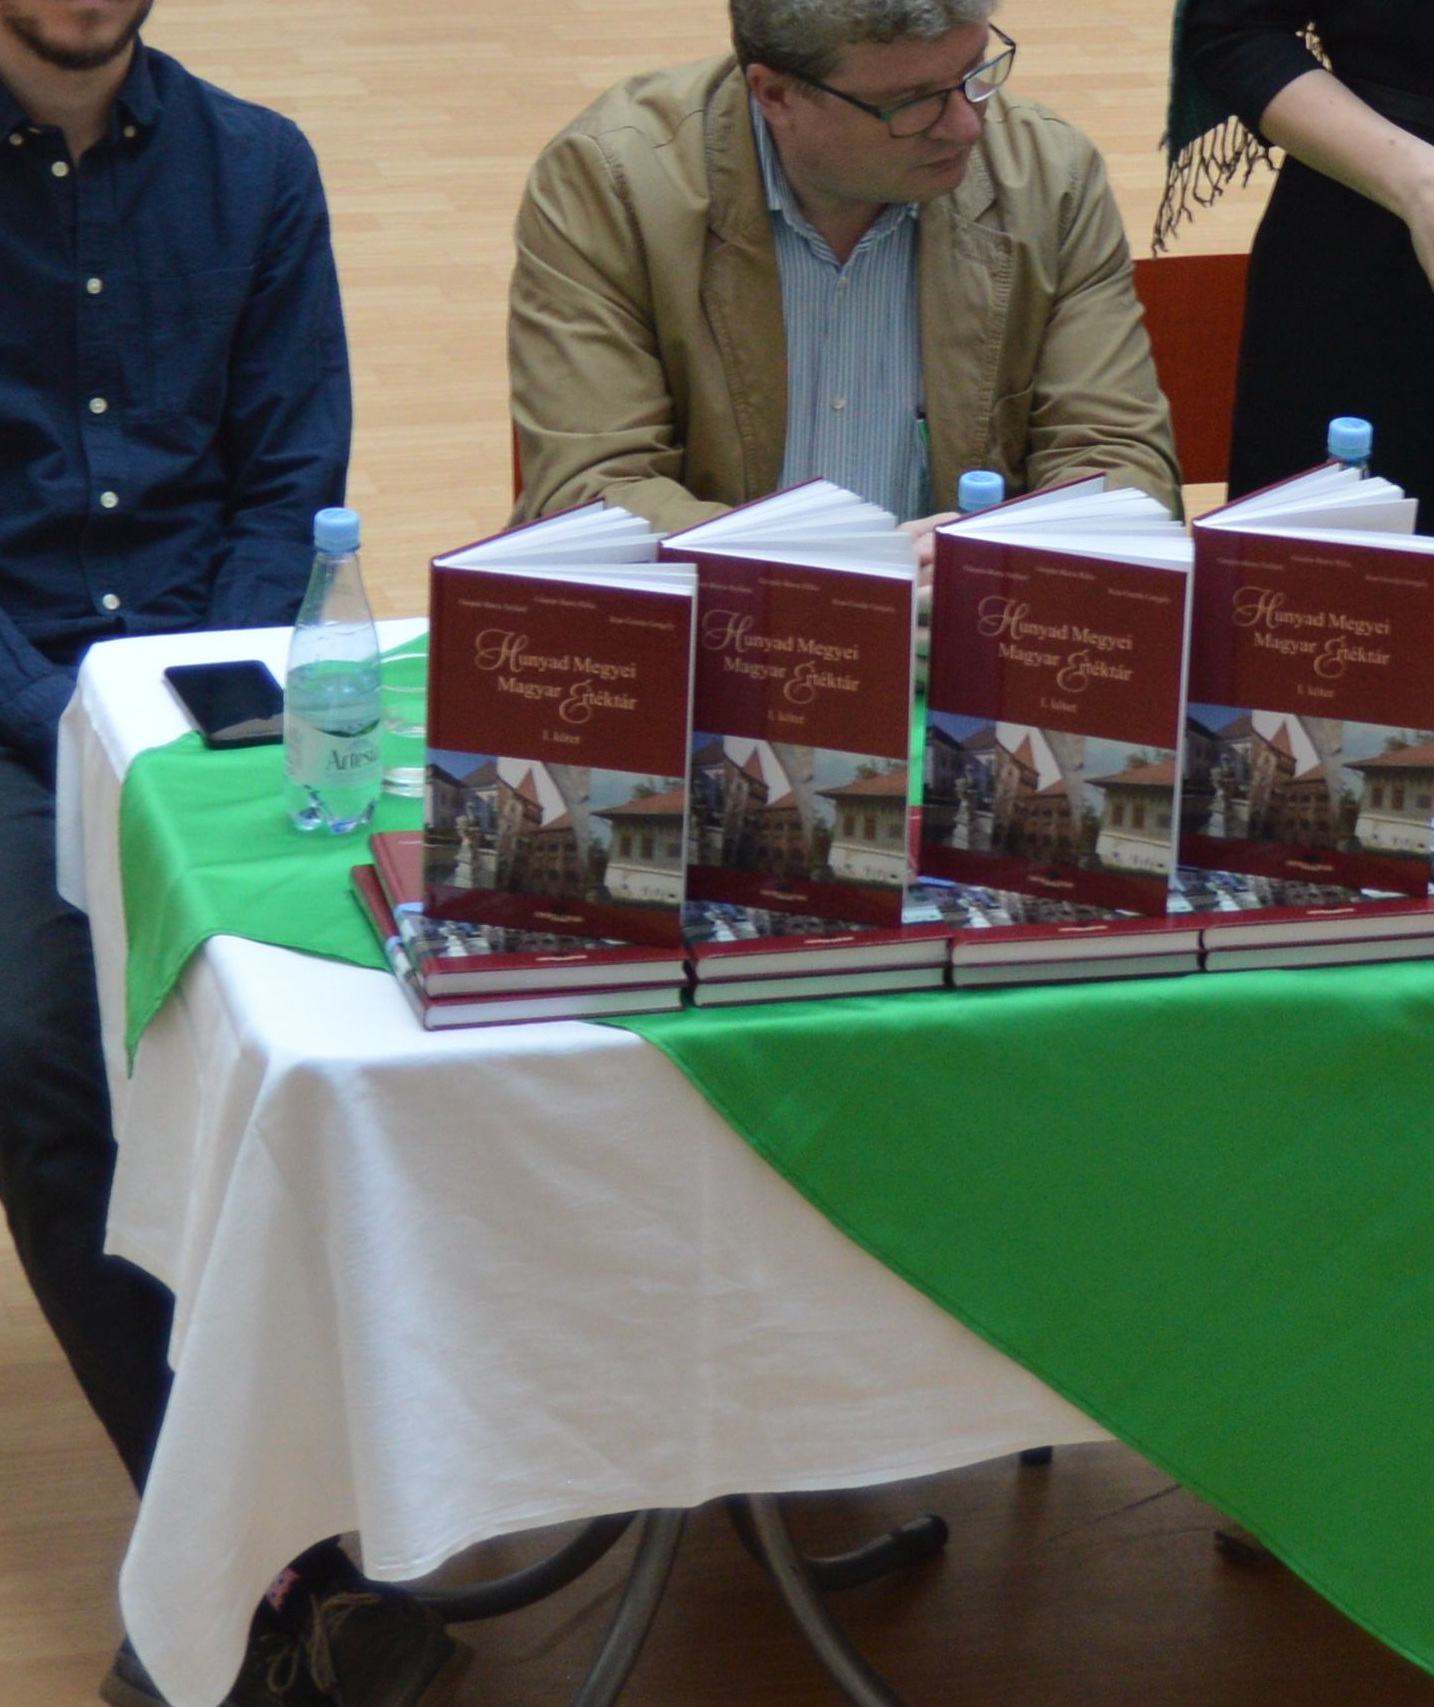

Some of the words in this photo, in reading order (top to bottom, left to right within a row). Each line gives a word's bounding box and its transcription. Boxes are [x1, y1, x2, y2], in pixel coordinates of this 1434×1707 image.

[977, 595, 1068, 640] Hunyad
[1072, 626, 1134, 650] Megyei
[1233, 585, 1325, 629] Hunyad
[1329, 612, 1391, 635] Megyei
[475, 628, 569, 672] Hunyad
[573, 656, 637, 680] Megyei
[702, 609, 795, 653] Hunyad
[797, 638, 859, 661] Megyei
[1254, 632, 1316, 655] Magyar
[1314, 635, 1391, 678] Értéktár
[723, 656, 787, 679] Magyar
[783, 660, 860, 704] Értéktár
[999, 643, 1061, 666] Magyar
[1057, 649, 1133, 692] Értéktár
[498, 676, 562, 699] Magyar
[559, 679, 637, 724] Értéktár
